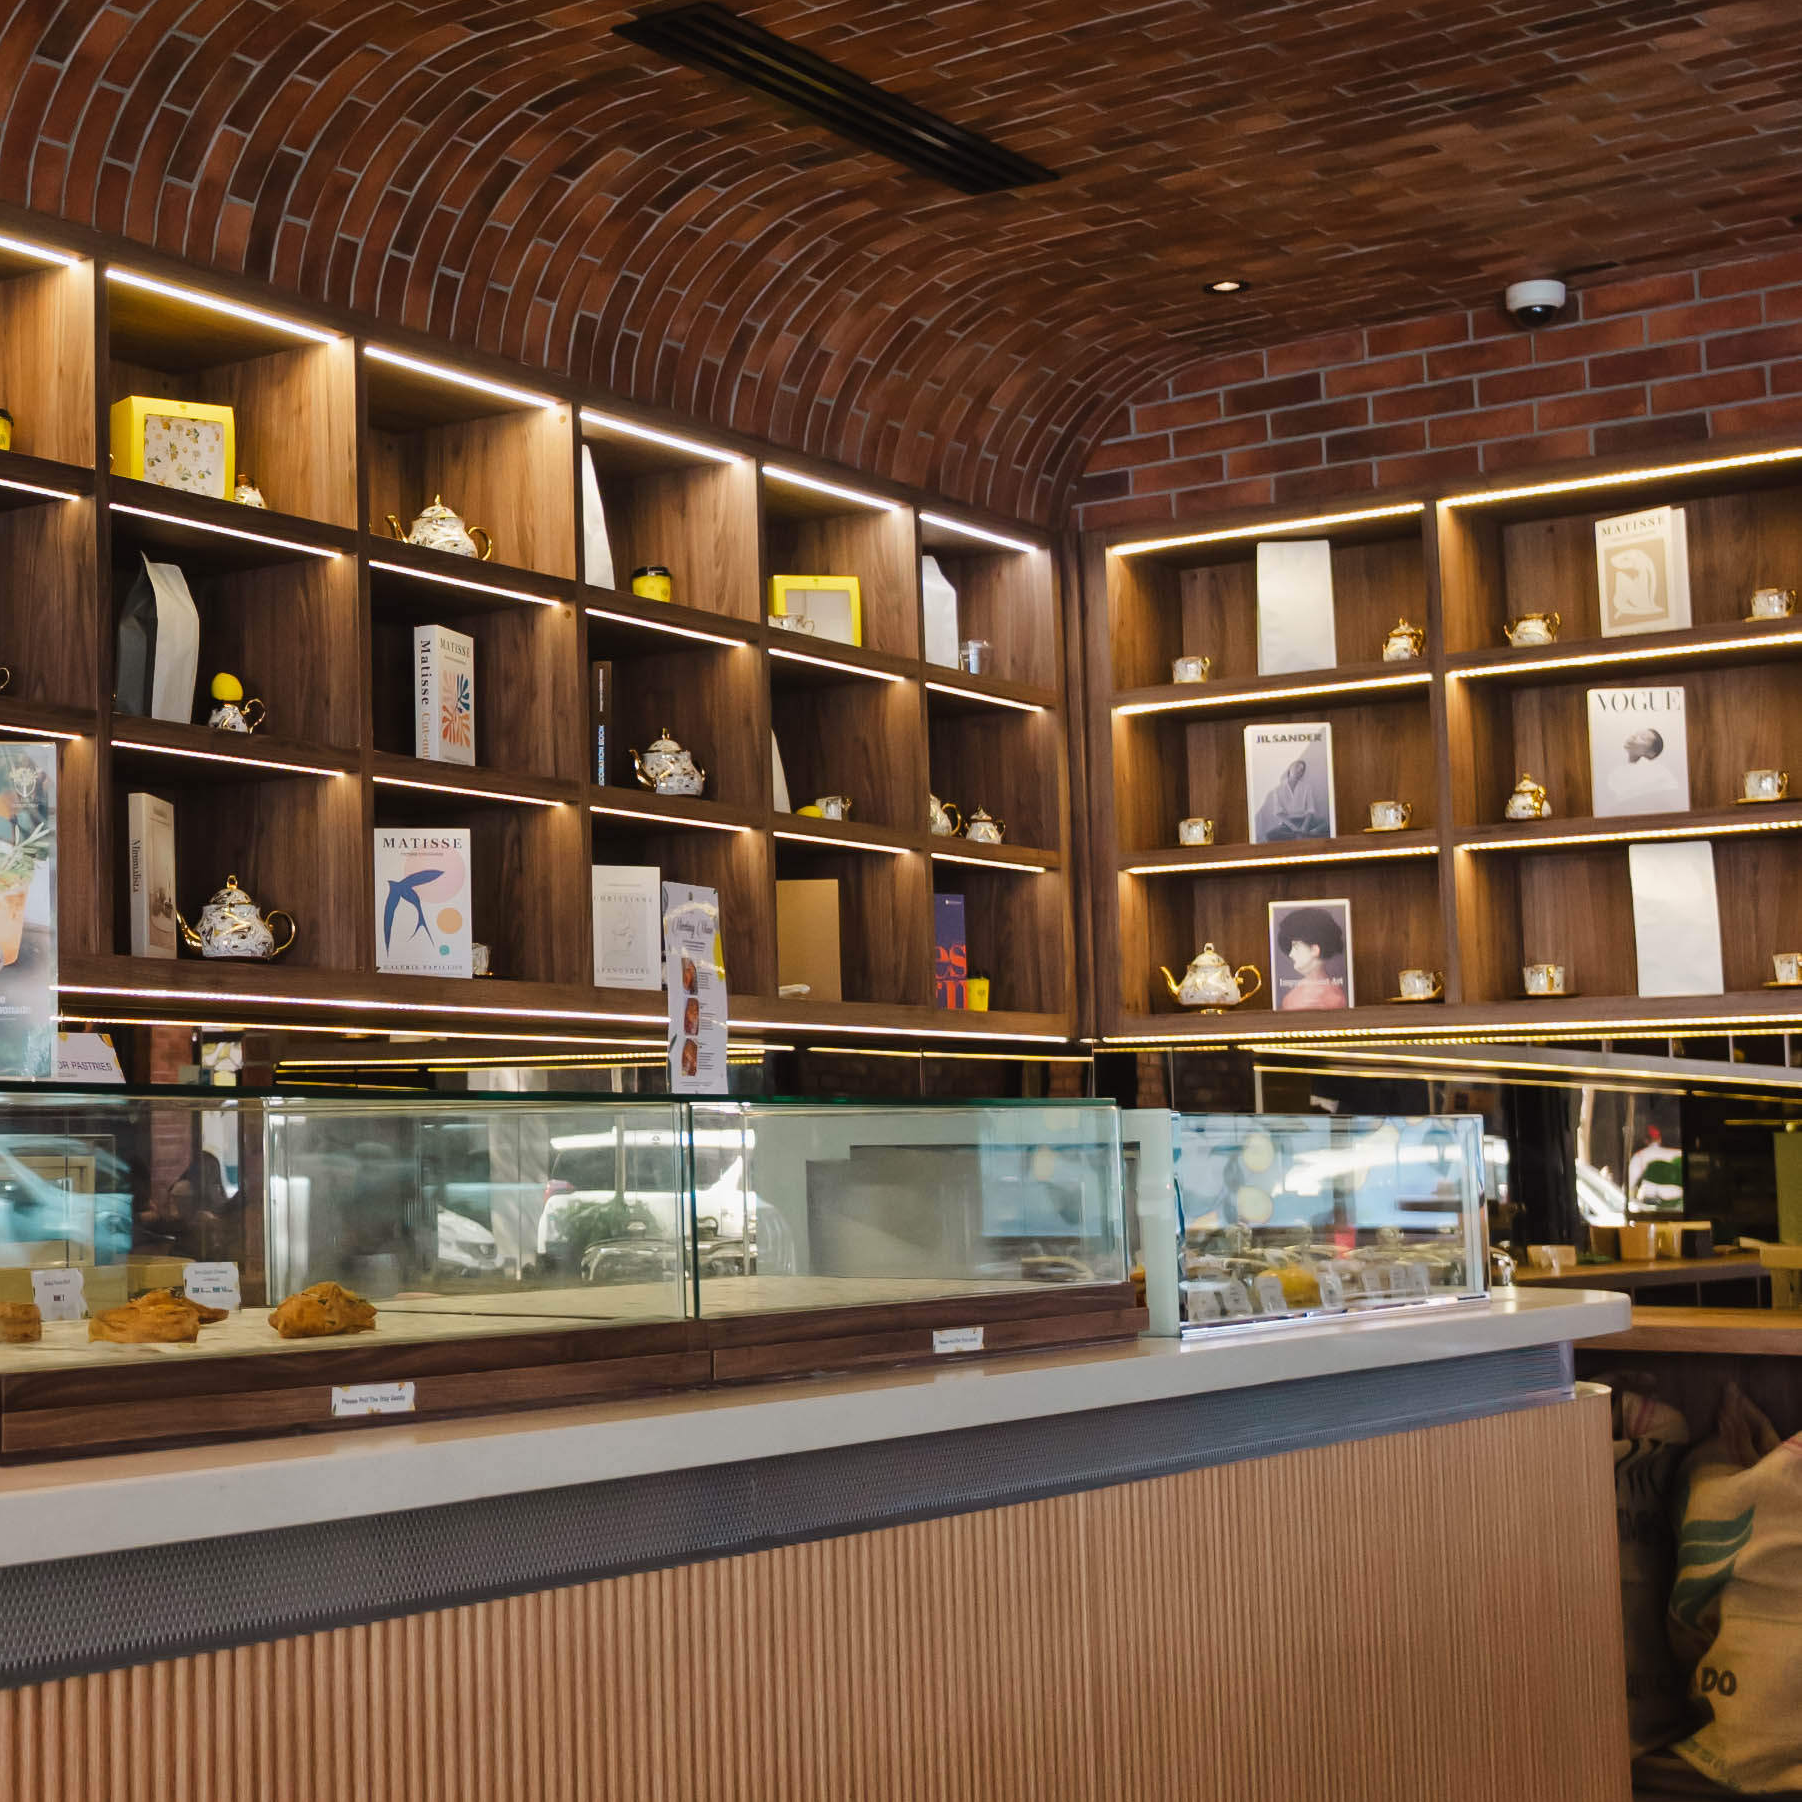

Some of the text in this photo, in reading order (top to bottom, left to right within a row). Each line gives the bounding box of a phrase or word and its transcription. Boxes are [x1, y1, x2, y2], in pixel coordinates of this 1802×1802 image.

[1600, 514, 1665, 537] MATISSE
[439, 637, 471, 659] MATISSE
[420, 639, 432, 705] Matisse
[1596, 690, 1681, 712] VOGUE
[1272, 733, 1322, 743] SANDER
[382, 837, 463, 849] MATISSE
[71, 1061, 113, 1071] PASTRIES
[1700, 1666, 1738, 1697] DO
